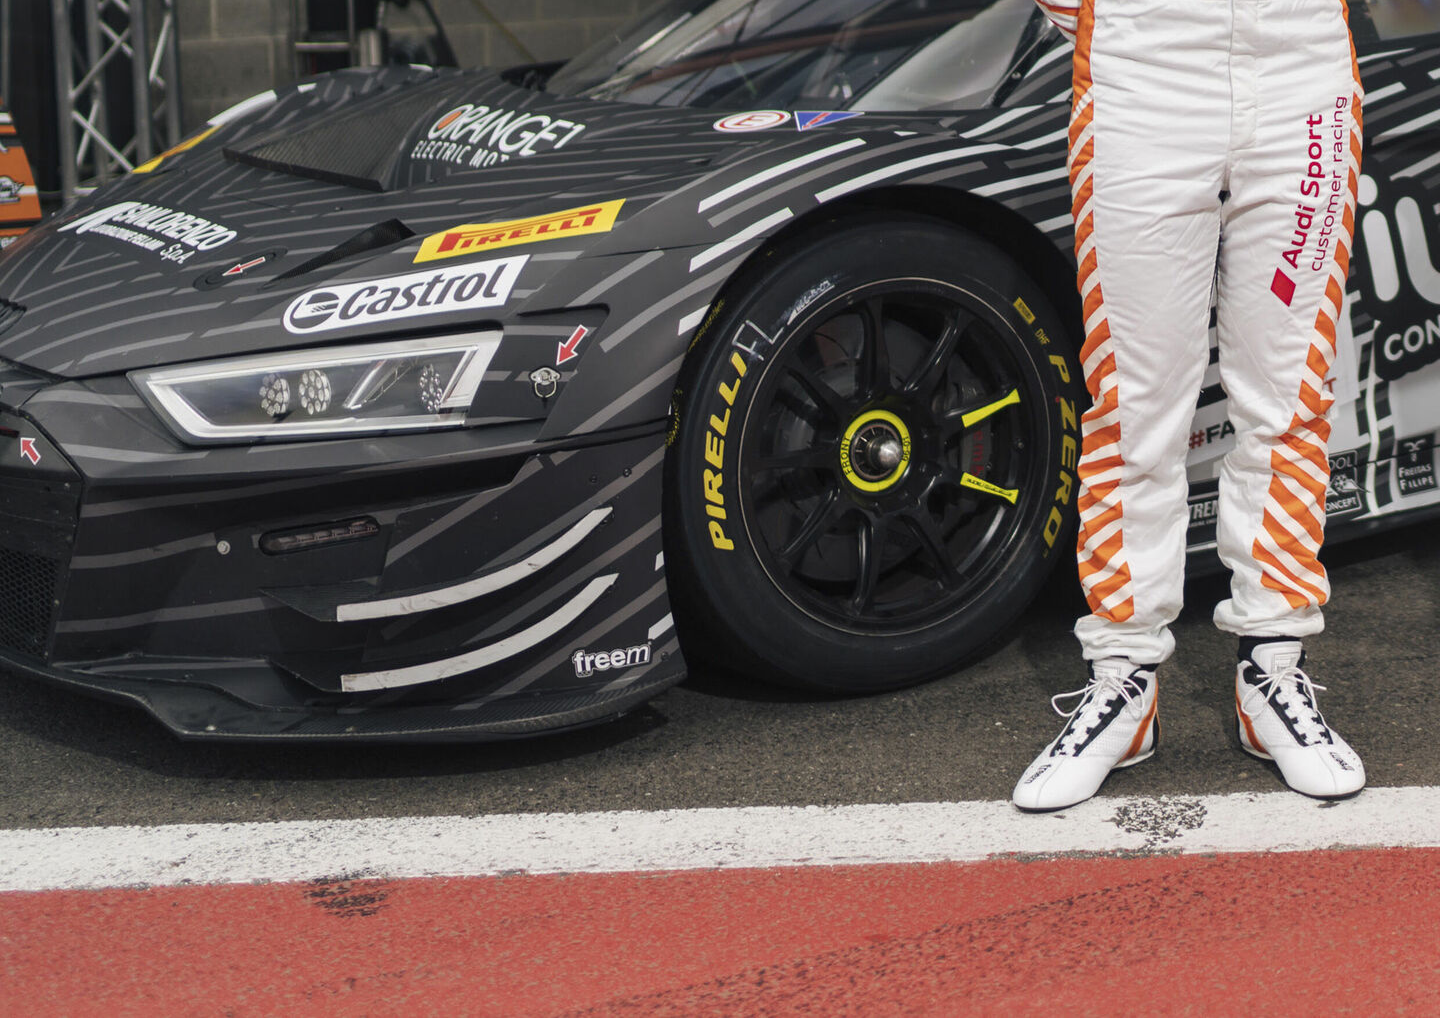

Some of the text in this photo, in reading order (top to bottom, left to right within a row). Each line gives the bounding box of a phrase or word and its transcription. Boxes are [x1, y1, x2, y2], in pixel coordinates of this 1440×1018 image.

[411, 140, 472, 164] ELECTRIC
[428, 104, 586, 157] ORANGE1
[1282, 114, 1325, 269] Audi Sport
[1312, 96, 1348, 271] customer racing
[113, 203, 238, 251] SANLORENZO
[436, 207, 603, 253] PIRELLI
[338, 262, 509, 321] Castrol
[703, 351, 748, 551] PIRELLI
[841, 437, 852, 476] FRONT
[1043, 354, 1077, 549] P ZERO
[1399, 463, 1433, 478] FREITAS
[1400, 476, 1435, 491] FILIPE
[571, 641, 653, 678] freem
